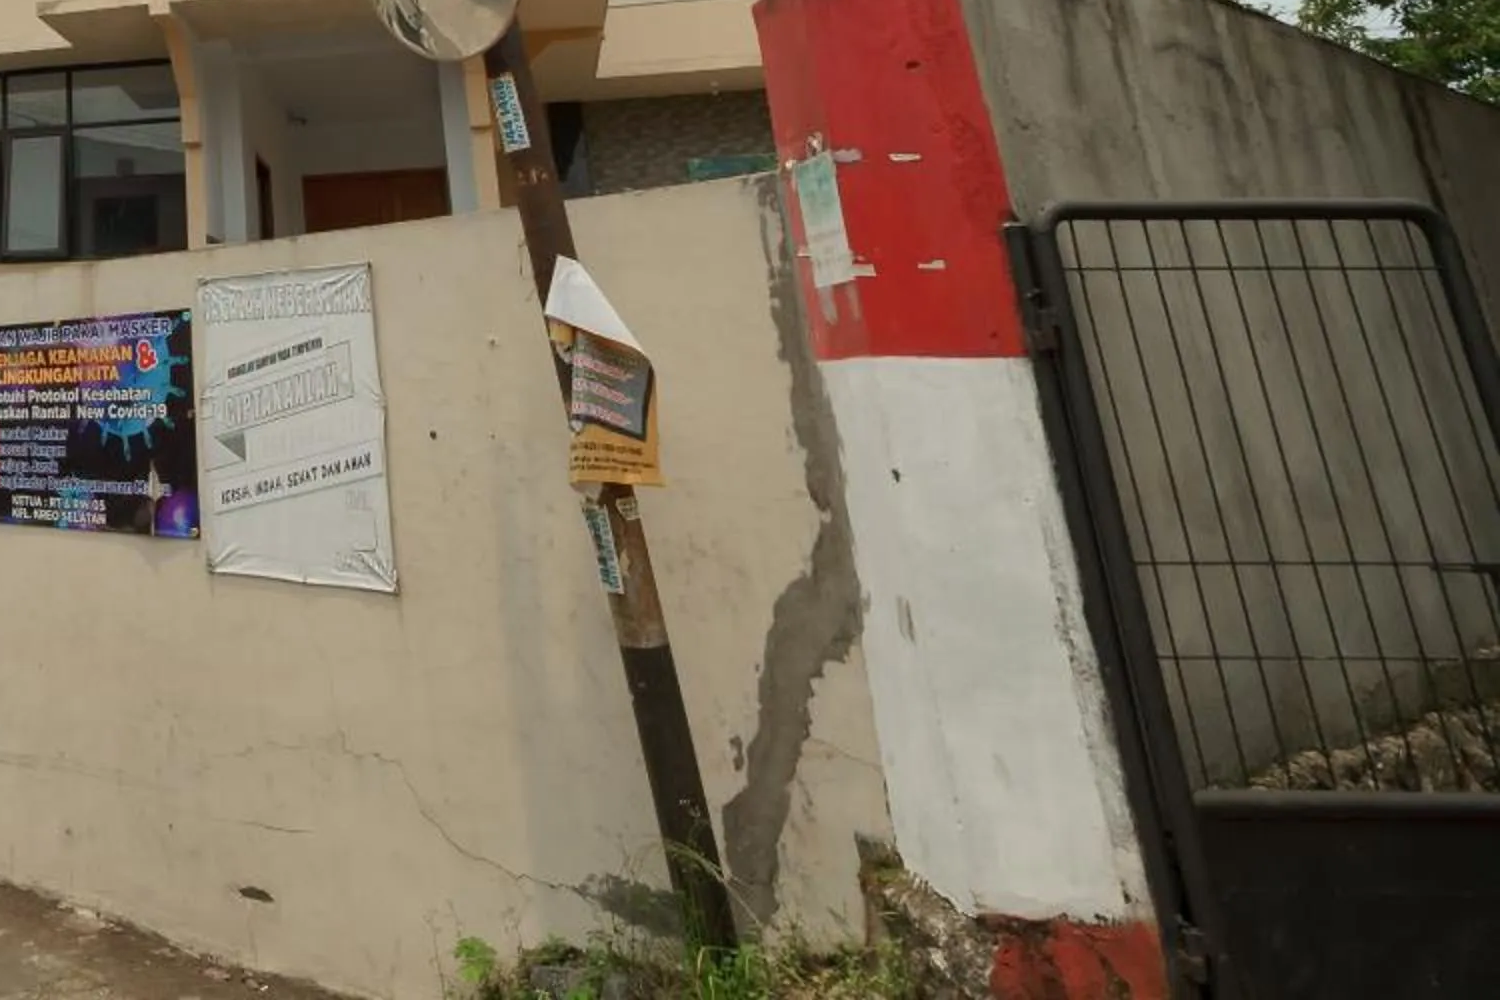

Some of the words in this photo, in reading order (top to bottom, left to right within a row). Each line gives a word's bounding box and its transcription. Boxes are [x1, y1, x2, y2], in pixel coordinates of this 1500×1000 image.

[107, 318, 172, 338] MASKER
[48, 344, 133, 365] KEAMANAN
[137, 339, 158, 373] &
[86, 365, 120, 382] KITA
[29, 388, 80, 403] Protokol
[83, 387, 151, 402] Kesehatan
[31, 405, 71, 420] Rantai
[77, 405, 104, 419] New
[108, 404, 168, 419] Covid-19
[322, 461, 341, 479] DAN
[343, 452, 372, 473] AMAN
